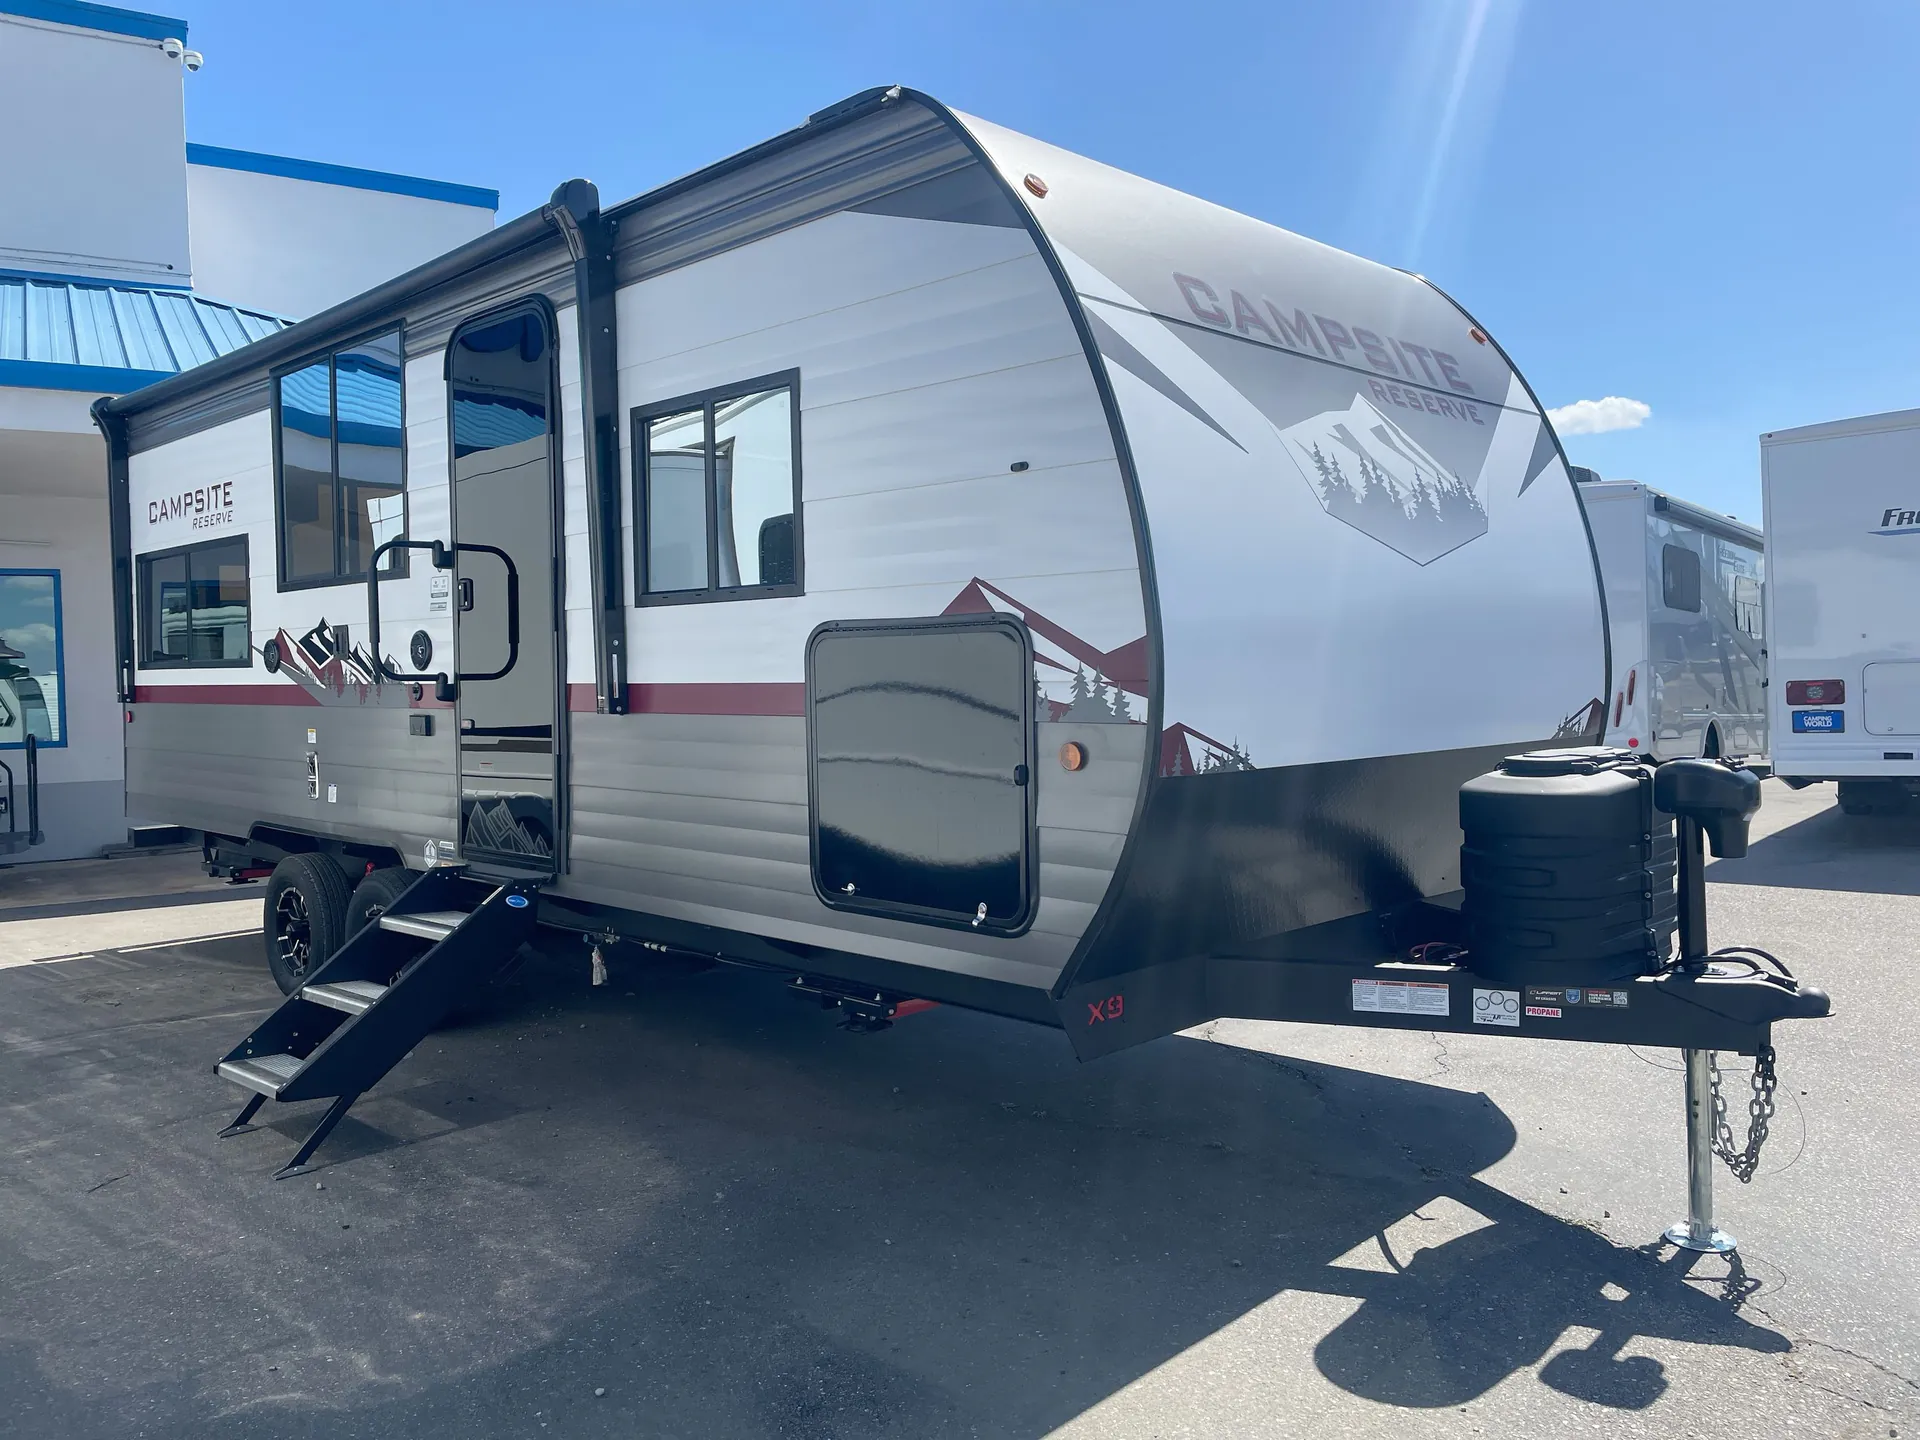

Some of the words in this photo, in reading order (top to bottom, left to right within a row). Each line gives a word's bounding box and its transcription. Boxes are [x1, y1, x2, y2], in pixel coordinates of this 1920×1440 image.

[1172, 271, 1475, 394] CAMPSITE
[1367, 379, 1485, 425] RESERVE
[149, 481, 233, 524] CAMPSITE
[192, 510, 233, 530] RESERVE
[1881, 508, 1920, 527] FR
[1803, 720, 1833, 728] WORLD
[1527, 1007, 1560, 1017] PROPANE
